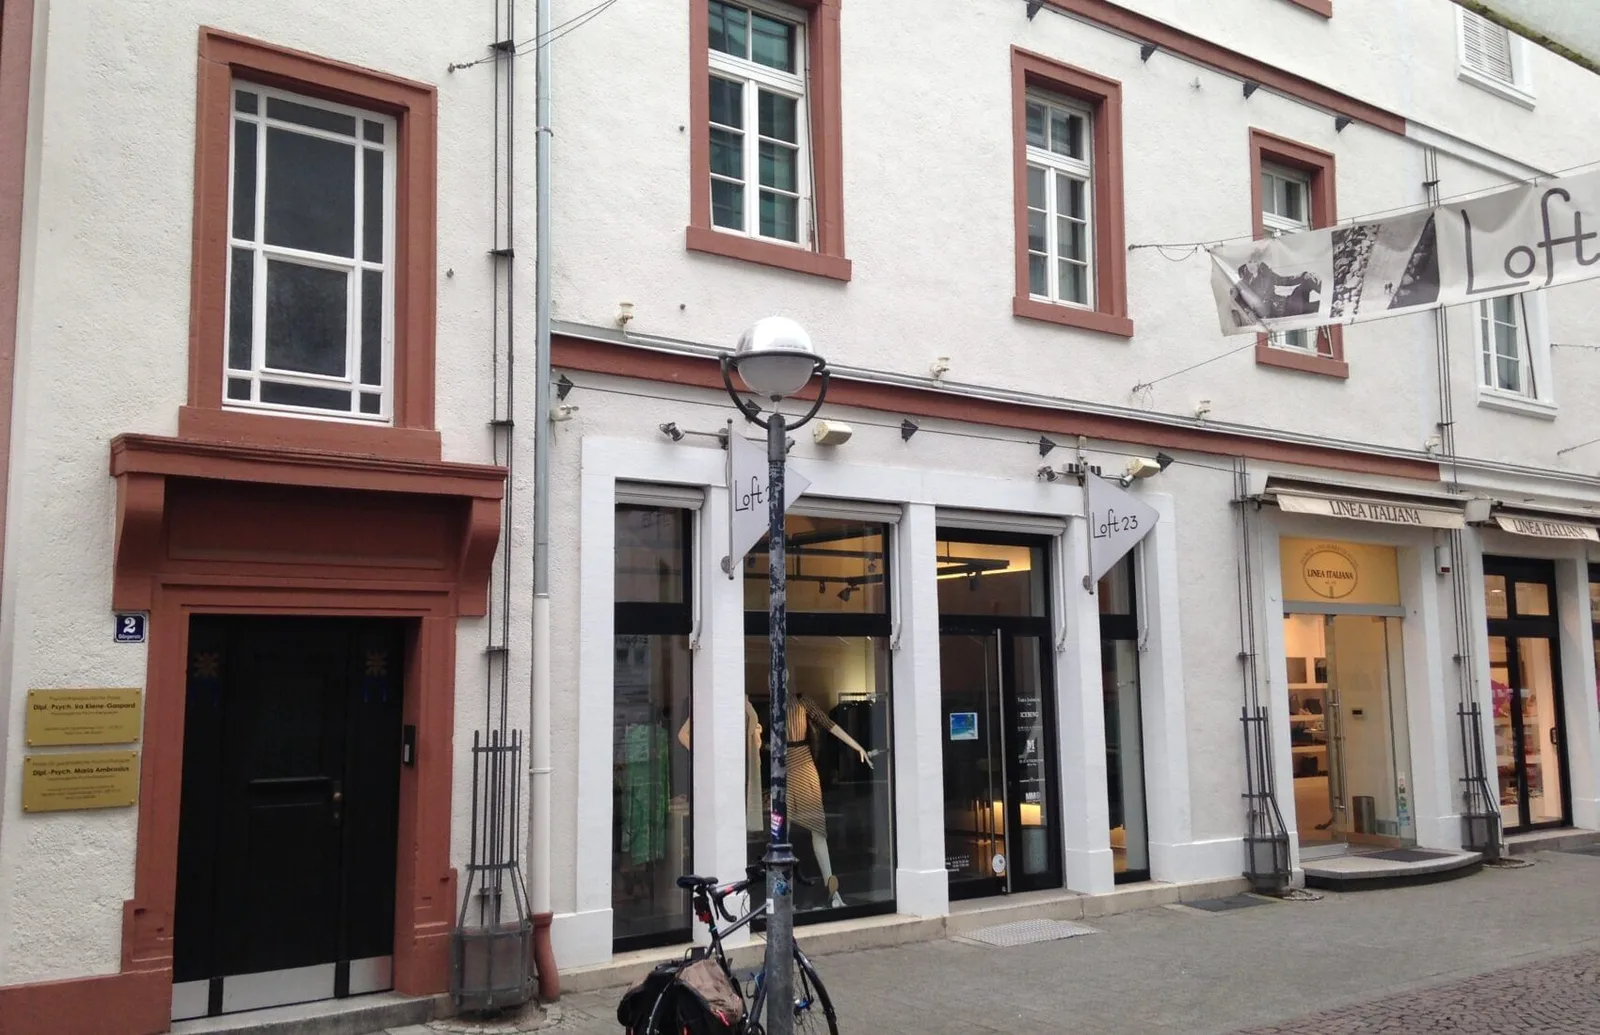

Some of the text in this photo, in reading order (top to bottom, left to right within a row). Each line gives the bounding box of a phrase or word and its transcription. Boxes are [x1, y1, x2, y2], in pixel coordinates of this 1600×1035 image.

[1460, 187, 1600, 295] Loft
[735, 475, 763, 512] Loft
[1092, 508, 1139, 539] Loft 23
[1329, 500, 1421, 524] LINEA ITALIANA
[1513, 519, 1588, 538] LINEA ITALIANA
[1307, 569, 1354, 580] LINEA ITALIANA
[123, 616, 136, 633] 2
